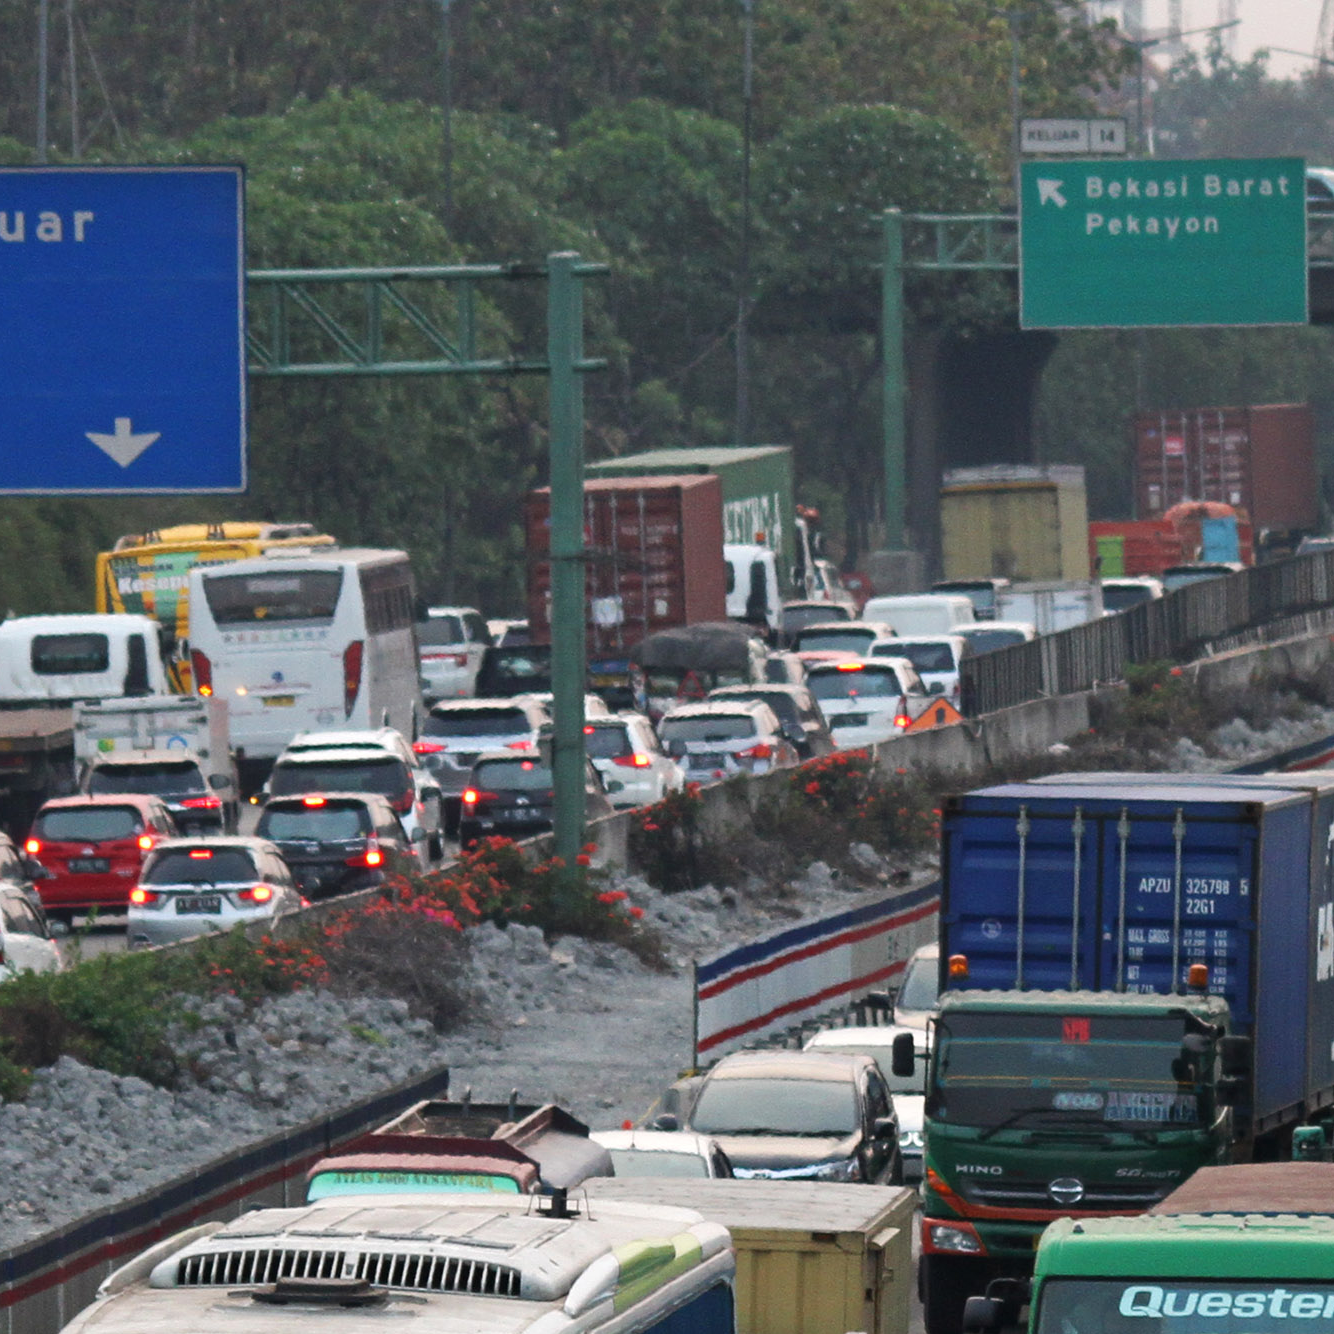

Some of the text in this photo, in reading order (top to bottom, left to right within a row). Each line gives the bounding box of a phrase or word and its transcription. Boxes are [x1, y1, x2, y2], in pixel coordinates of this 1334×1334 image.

[1100, 129, 1115, 142] 14
[1085, 175, 1291, 199] Bekasi Barat
[1085, 214, 1220, 242] Pekayon
[1139, 878, 1249, 896] APZU 325798 5
[1185, 899, 1215, 915] 22G1
[955, 1164, 1004, 1177] HINO
